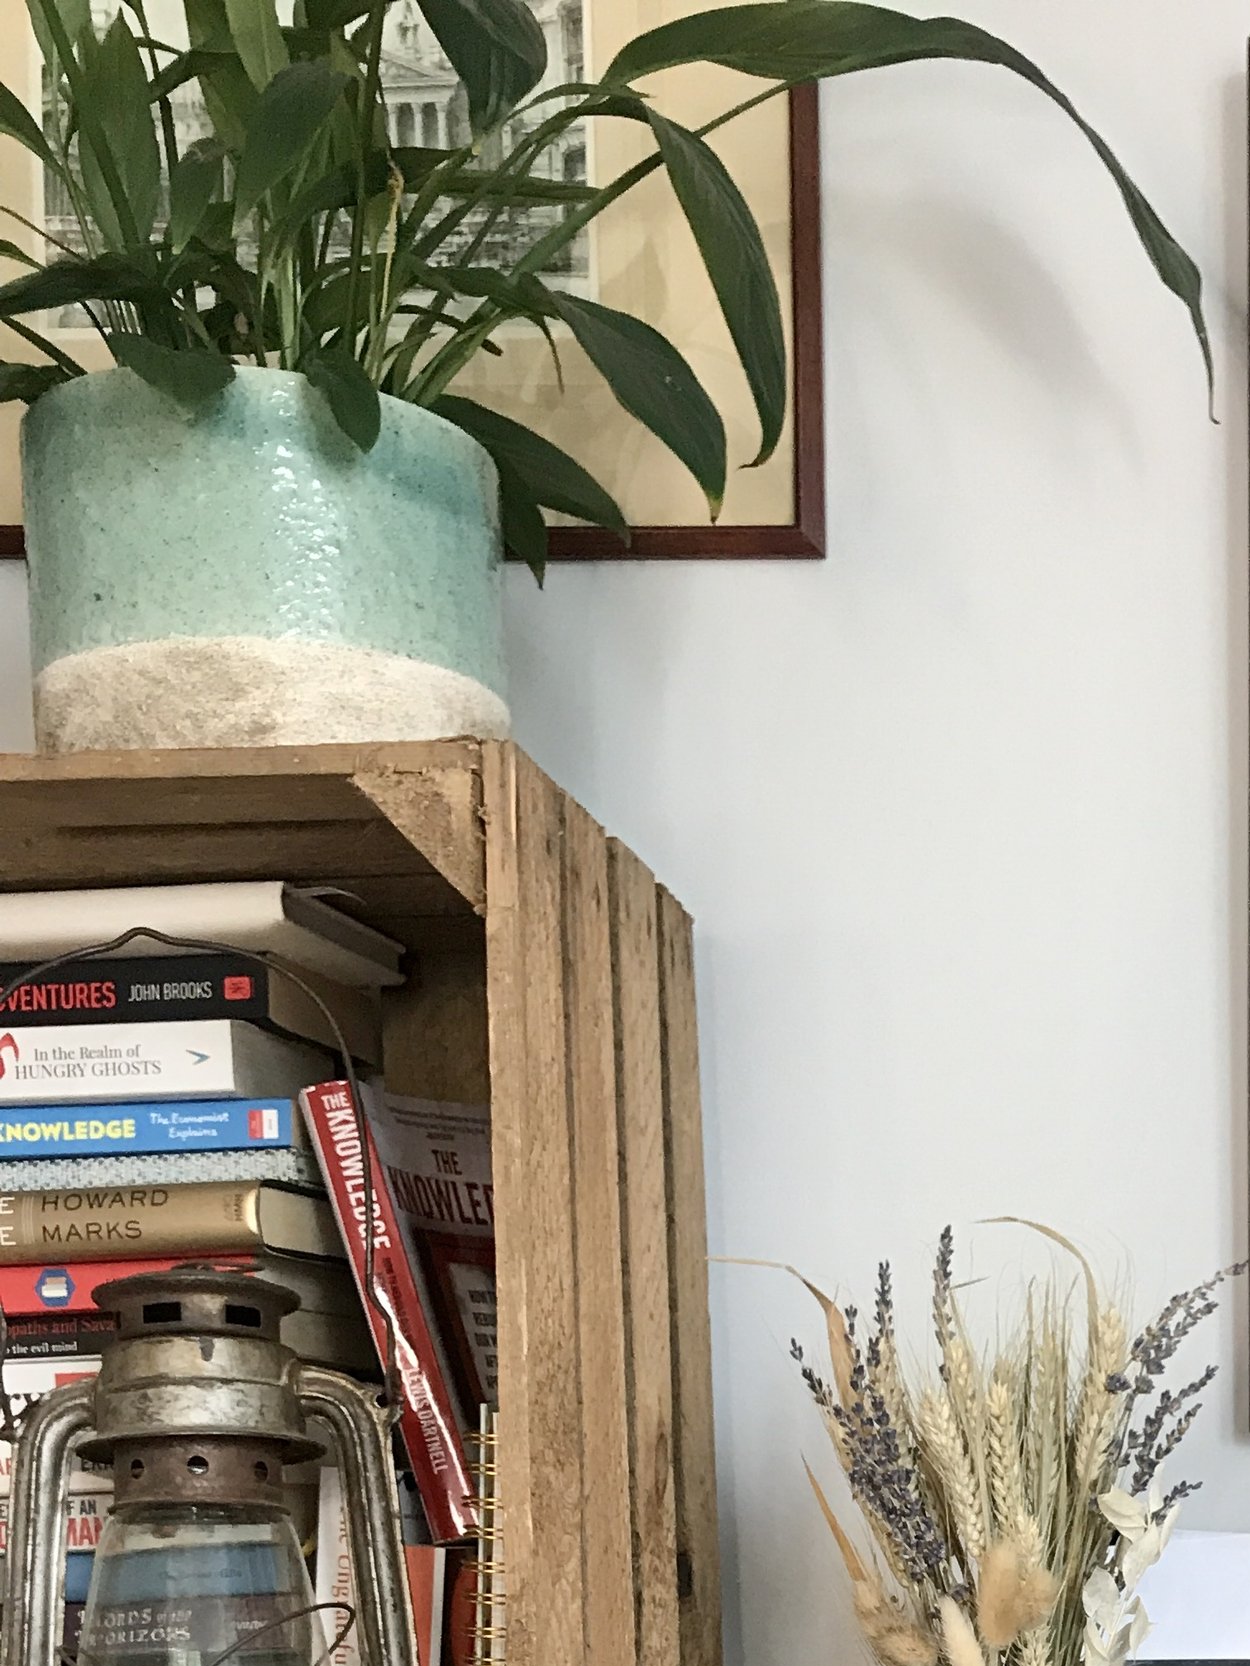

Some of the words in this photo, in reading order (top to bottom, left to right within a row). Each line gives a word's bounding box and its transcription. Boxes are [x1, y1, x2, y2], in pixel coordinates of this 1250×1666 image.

[128, 983, 161, 1002] JOHN
[163, 981, 213, 1001] BROOKS
[34, 1048, 49, 1062] In
[52, 1045, 76, 1061] the
[79, 1044, 122, 1061] Realm
[125, 1043, 142, 1058] of
[14, 1061, 88, 1080] HUNGRY
[91, 1059, 163, 1077] GHOSTS
[321, 1091, 348, 1110] THE
[150, 1111, 170, 1125] The
[168, 1127, 219, 1141] Explains
[430, 1149, 463, 1176] THE
[41, 1189, 170, 1213] HOWARD
[41, 1219, 143, 1243] MARKS
[52, 1317, 78, 1334] and
[11, 1343, 29, 1355] the
[31, 1341, 49, 1354] evil
[51, 1341, 78, 1353] mind
[415, 1408, 448, 1475] DARTNELL
